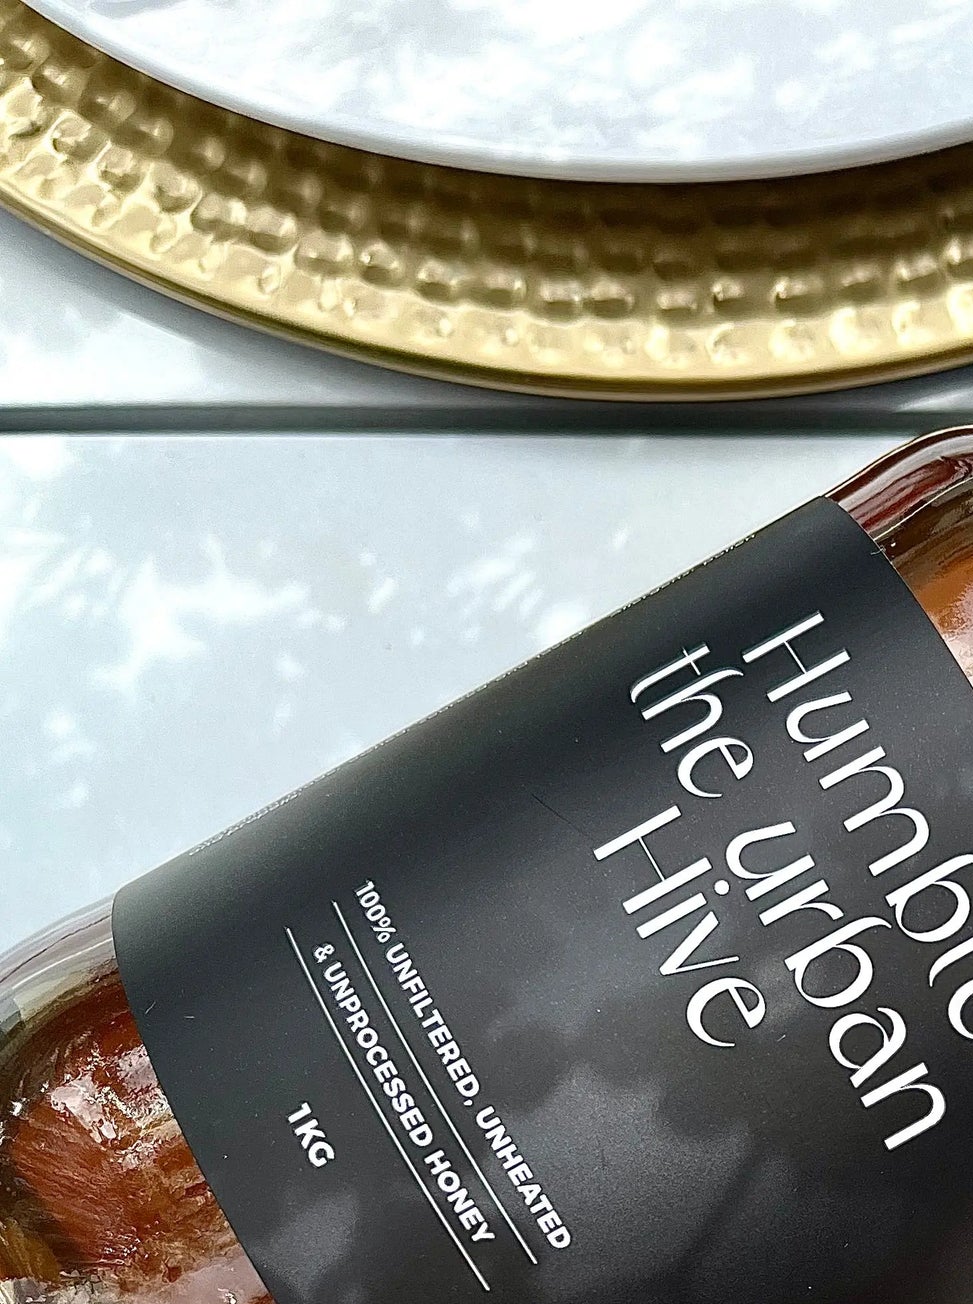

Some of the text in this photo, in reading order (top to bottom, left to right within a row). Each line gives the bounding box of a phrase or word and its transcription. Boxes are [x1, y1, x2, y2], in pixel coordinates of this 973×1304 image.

[593, 805, 766, 1047] Hive
[631, 642, 946, 1151] the urban
[287, 1102, 335, 1168] 1KG
[314, 944, 496, 1242] & UNPROCESSED HONEY
[354, 879, 572, 1249] 100% UNFILTERED, UNHEATED
